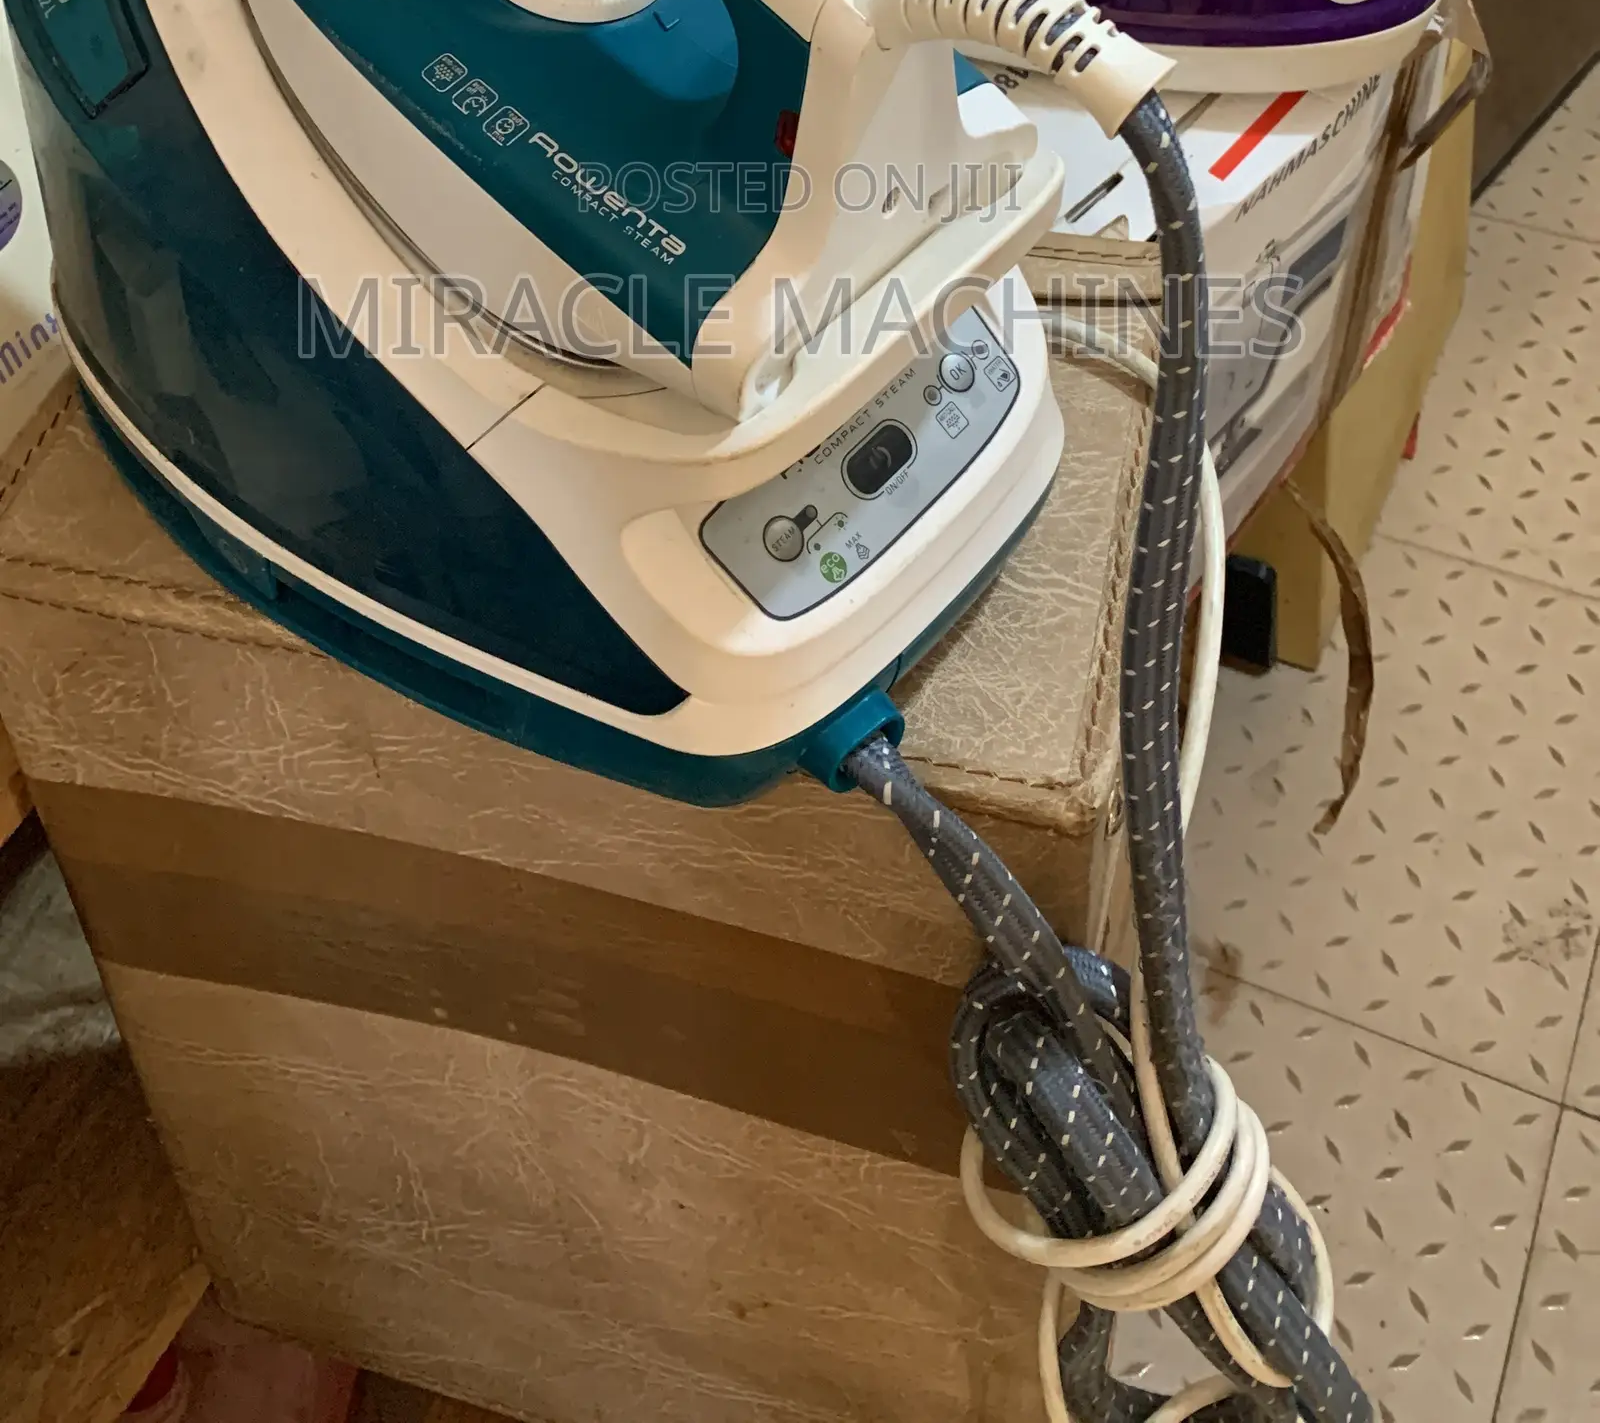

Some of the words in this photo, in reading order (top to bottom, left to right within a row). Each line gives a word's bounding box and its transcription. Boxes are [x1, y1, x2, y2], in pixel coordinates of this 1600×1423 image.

[551, 169, 619, 222] COMPACT
[622, 225, 675, 265] STEAM
[949, 363, 967, 381] OK
[813, 408, 872, 465] COMPACT
[875, 368, 916, 409] STEAM
[884, 468, 911, 496] ON/OFF
[771, 527, 796, 553] STEAM
[845, 532, 863, 550] MAX
[820, 553, 841, 575] eco
